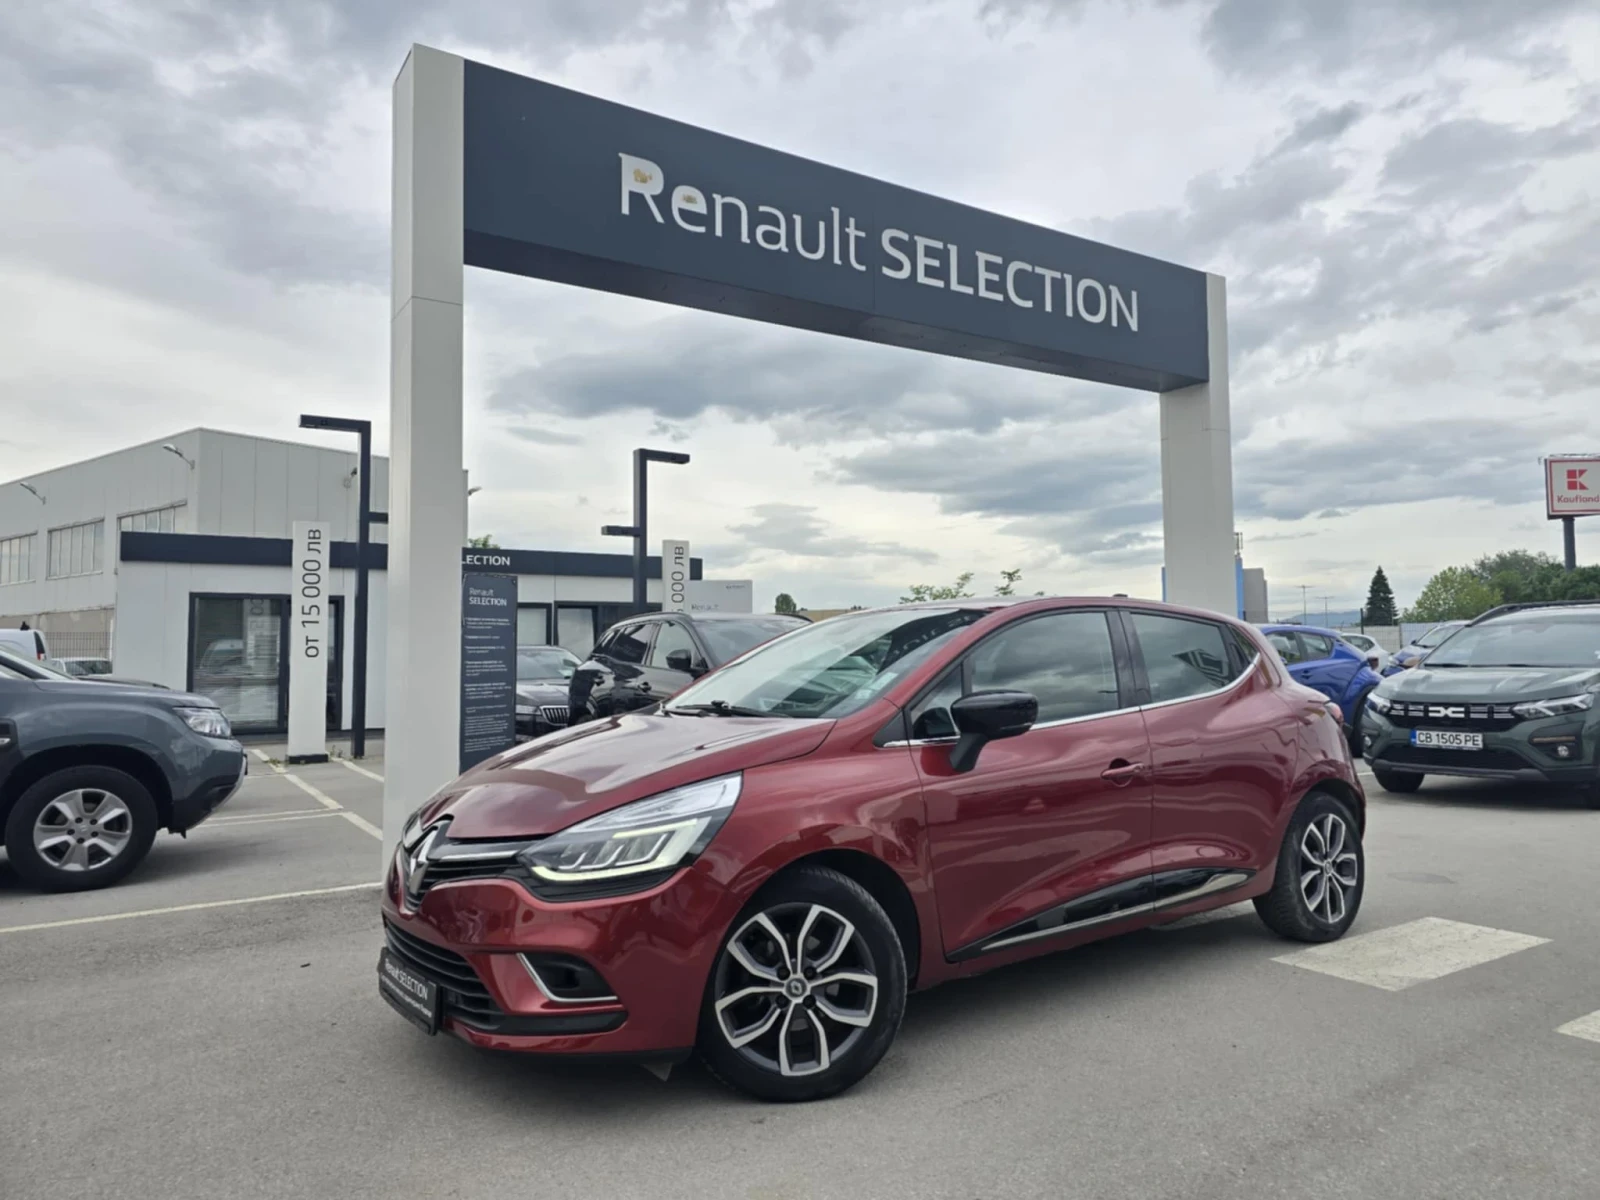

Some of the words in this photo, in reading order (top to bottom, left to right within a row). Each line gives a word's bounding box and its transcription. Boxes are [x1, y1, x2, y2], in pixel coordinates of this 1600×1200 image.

[618, 152, 868, 272] Renault
[880, 228, 1140, 333] SELECTION
[1557, 494, 1600, 503] Kaufland
[462, 554, 511, 566] ECTION
[302, 559, 321, 599] 000
[671, 571, 685, 604] 000
[469, 596, 507, 606] SELECTION
[302, 604, 320, 629] 15
[1417, 732, 1432, 743] CB
[1435, 733, 1462, 745] 1505
[1464, 735, 1479, 746] PE
